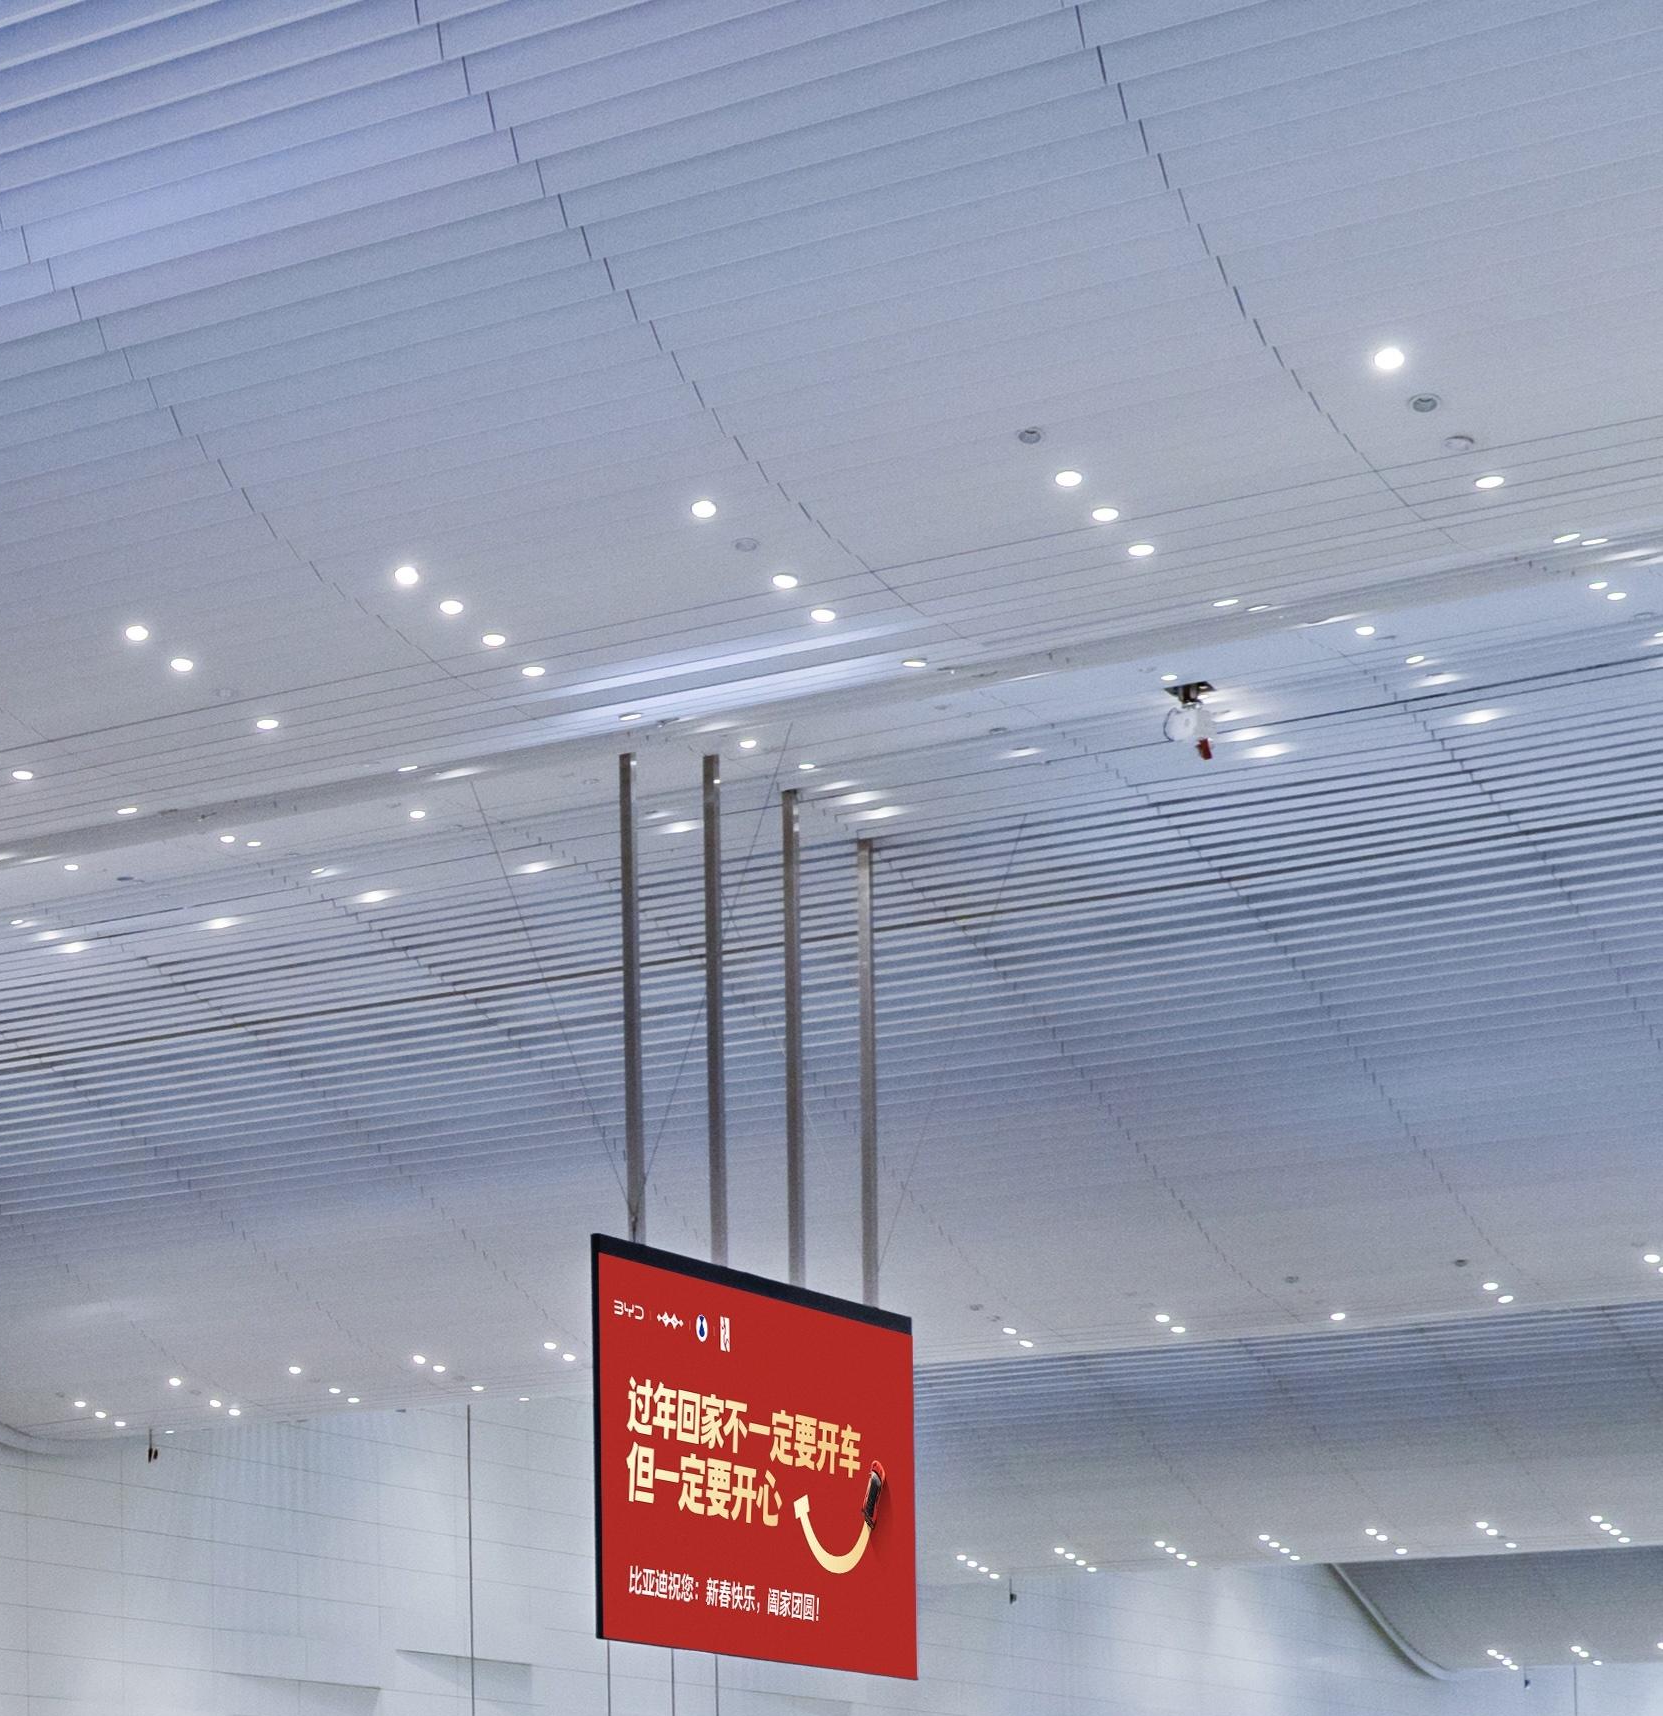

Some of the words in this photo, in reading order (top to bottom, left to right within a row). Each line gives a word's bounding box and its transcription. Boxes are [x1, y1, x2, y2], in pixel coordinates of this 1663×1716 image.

[613, 1299, 645, 1321] BYD
[626, 1376, 862, 1478] 过年回家不一定要开车
[626, 1442, 783, 1527] 但一定要开心
